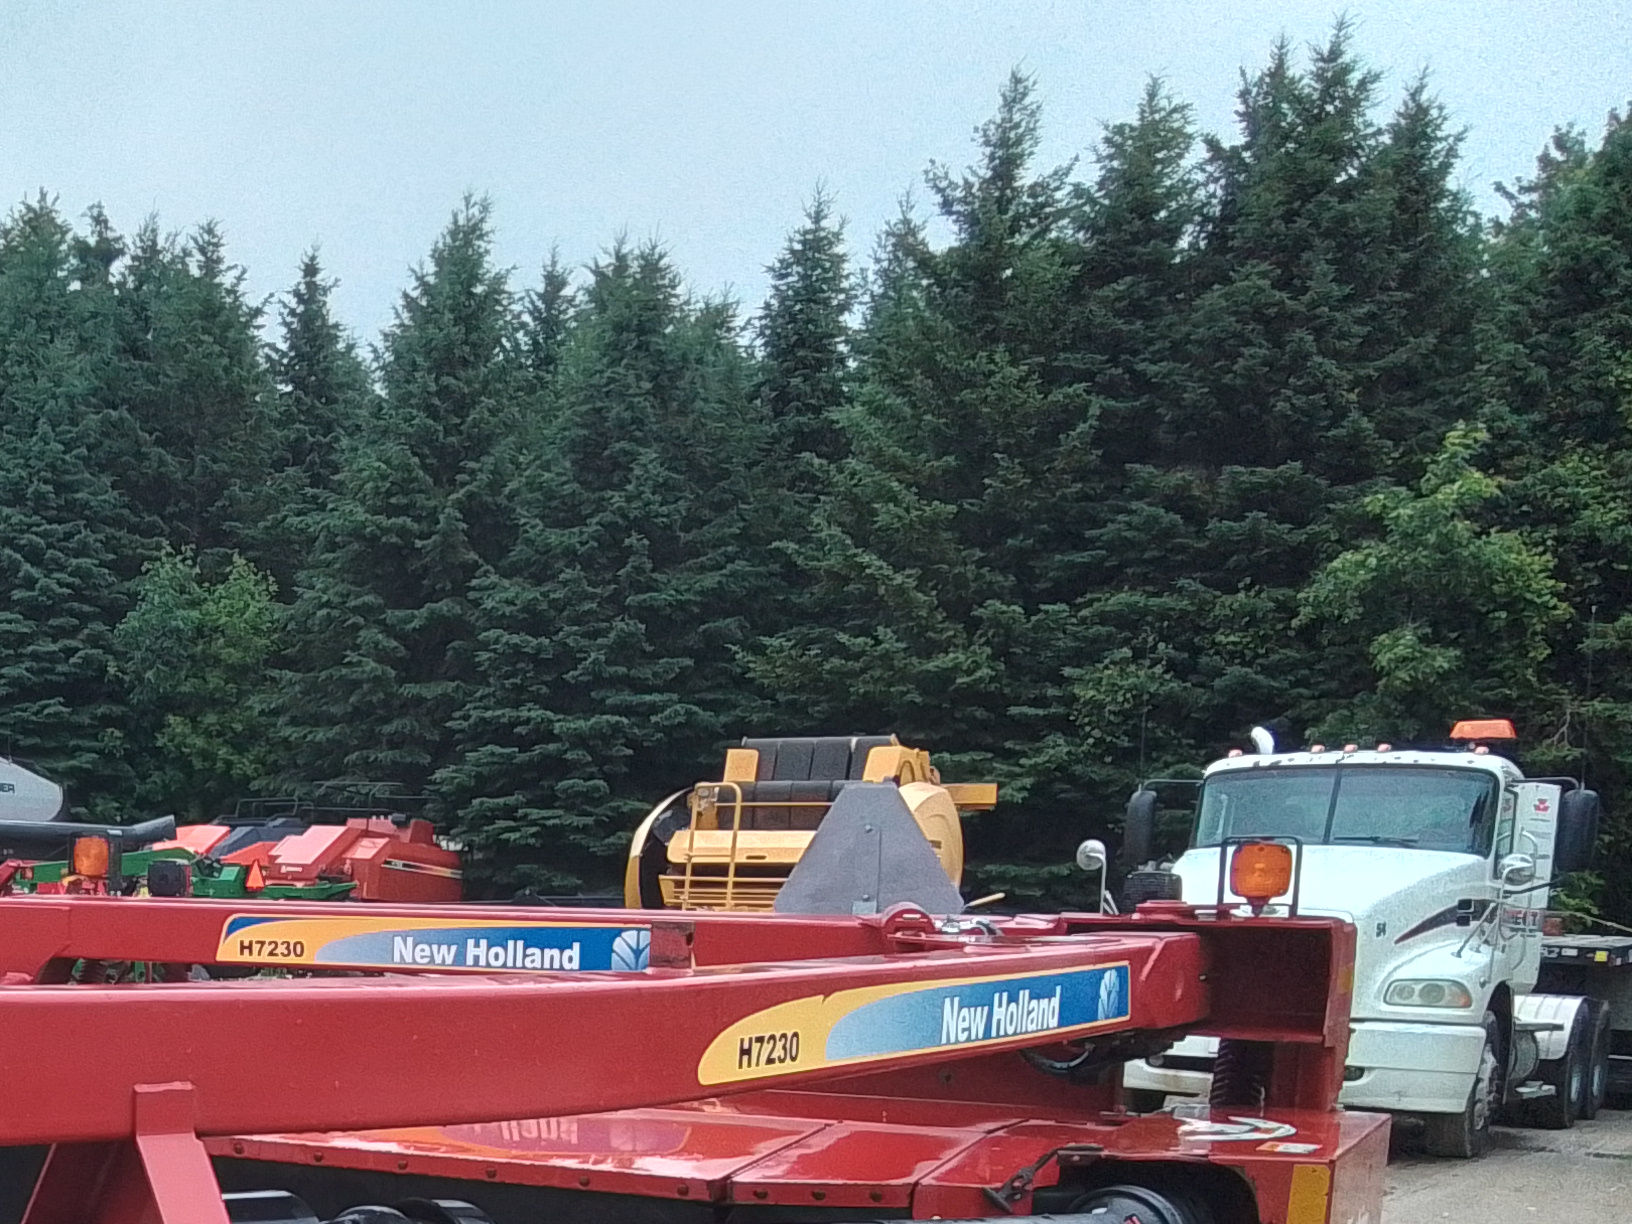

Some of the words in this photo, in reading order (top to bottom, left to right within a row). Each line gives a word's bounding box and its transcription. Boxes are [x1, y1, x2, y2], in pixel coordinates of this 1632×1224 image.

[239, 939, 305, 958] H7230
[393, 936, 457, 965] New
[466, 938, 580, 970] Holland
[940, 996, 990, 1045] New
[991, 985, 1062, 1037] Holland
[737, 1031, 800, 1070] H7230
